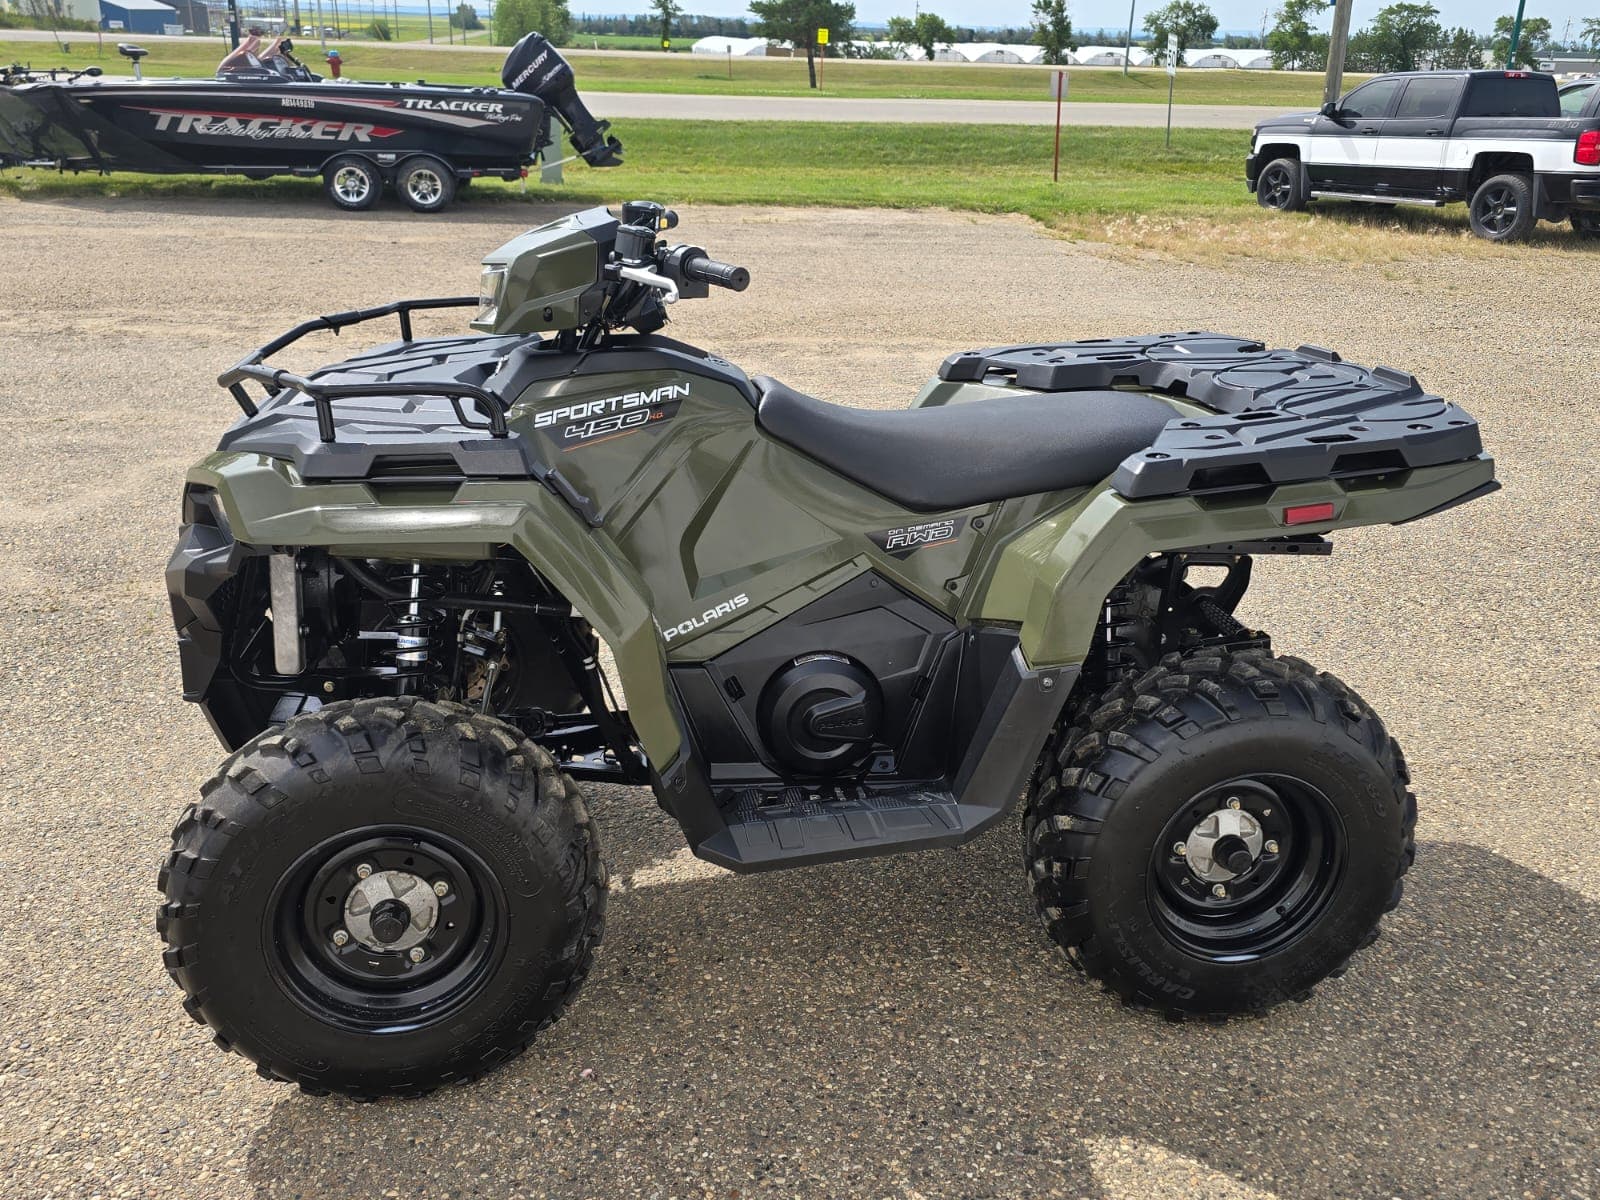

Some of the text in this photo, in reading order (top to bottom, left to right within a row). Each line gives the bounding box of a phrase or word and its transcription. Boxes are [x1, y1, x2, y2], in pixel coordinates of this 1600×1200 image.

[512, 49, 548, 89] MERCURY
[402, 98, 504, 113] TRACKER
[149, 111, 377, 143] TRACKER
[534, 382, 690, 428] SPORTSMAN
[564, 408, 651, 439] 450
[886, 526, 954, 549] AWD
[908, 519, 955, 532] DEMAND
[663, 593, 750, 642] POLARIS
